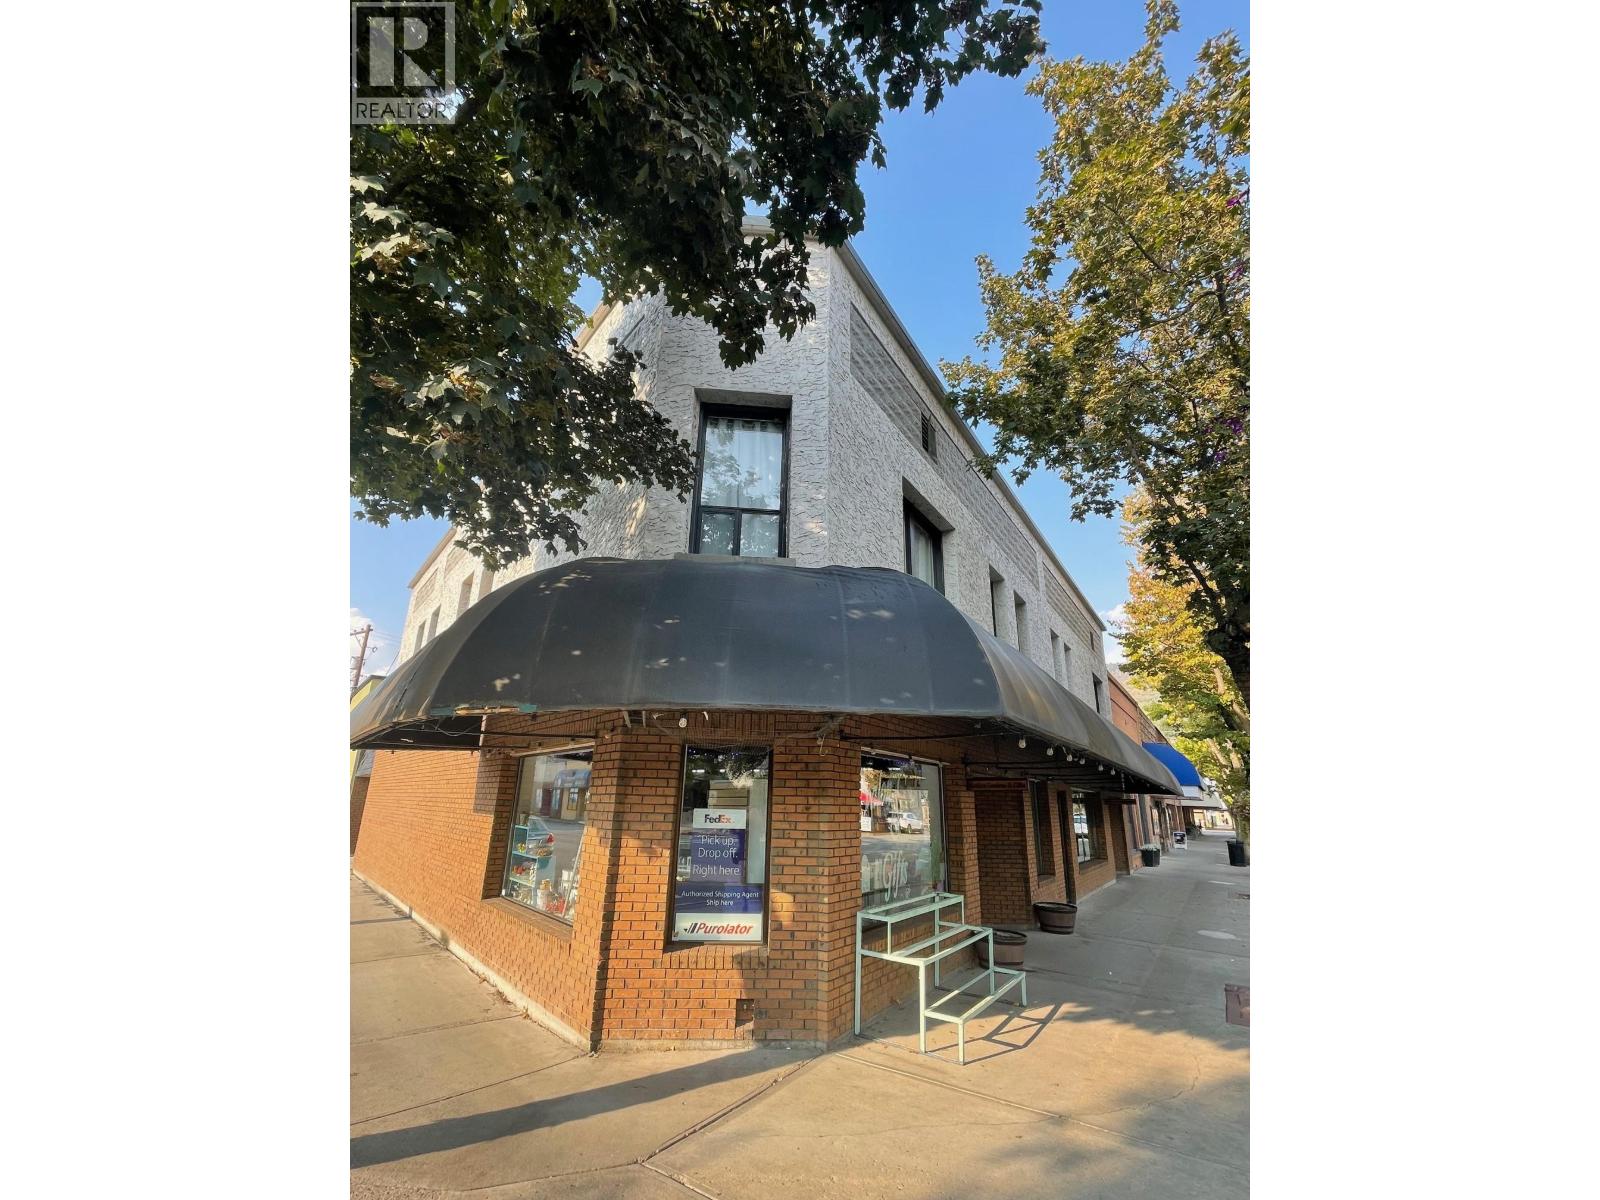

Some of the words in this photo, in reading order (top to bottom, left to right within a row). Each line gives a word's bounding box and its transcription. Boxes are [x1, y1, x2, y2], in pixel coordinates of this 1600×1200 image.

[704, 814, 732, 824] FedEx
[701, 835, 720, 845] Pick
[698, 847, 721, 860] Drop
[722, 847, 738, 858] off.
[692, 864, 716, 878] Right
[681, 890, 714, 898] Authorized
[714, 890, 741, 899] Shipping
[741, 891, 759, 899] Agent
[696, 922, 753, 935] Purolator
